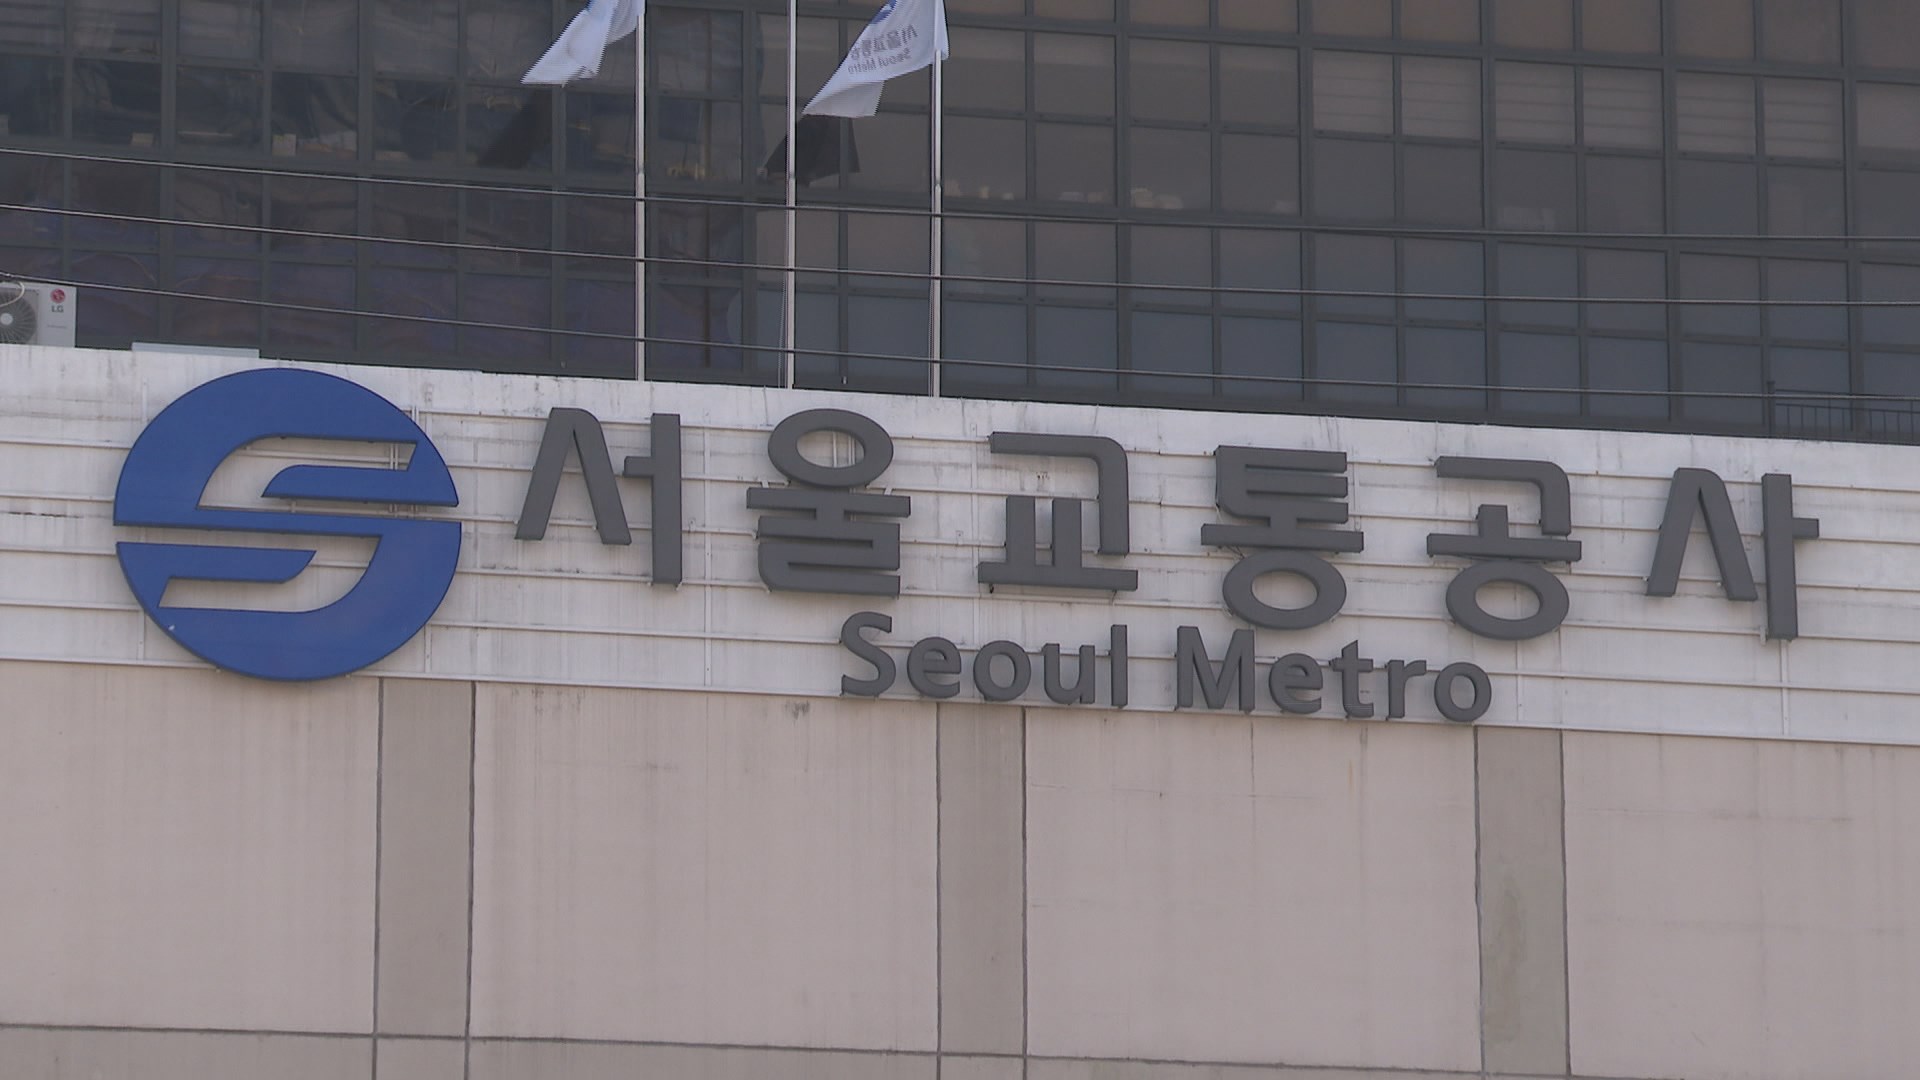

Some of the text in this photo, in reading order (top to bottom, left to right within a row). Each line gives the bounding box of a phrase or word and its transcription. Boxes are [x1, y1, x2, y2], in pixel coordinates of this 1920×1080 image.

[51, 305, 64, 313] LG
[515, 407, 1820, 641] 서울교통공사
[840, 611, 1492, 722] Seoul Metro
